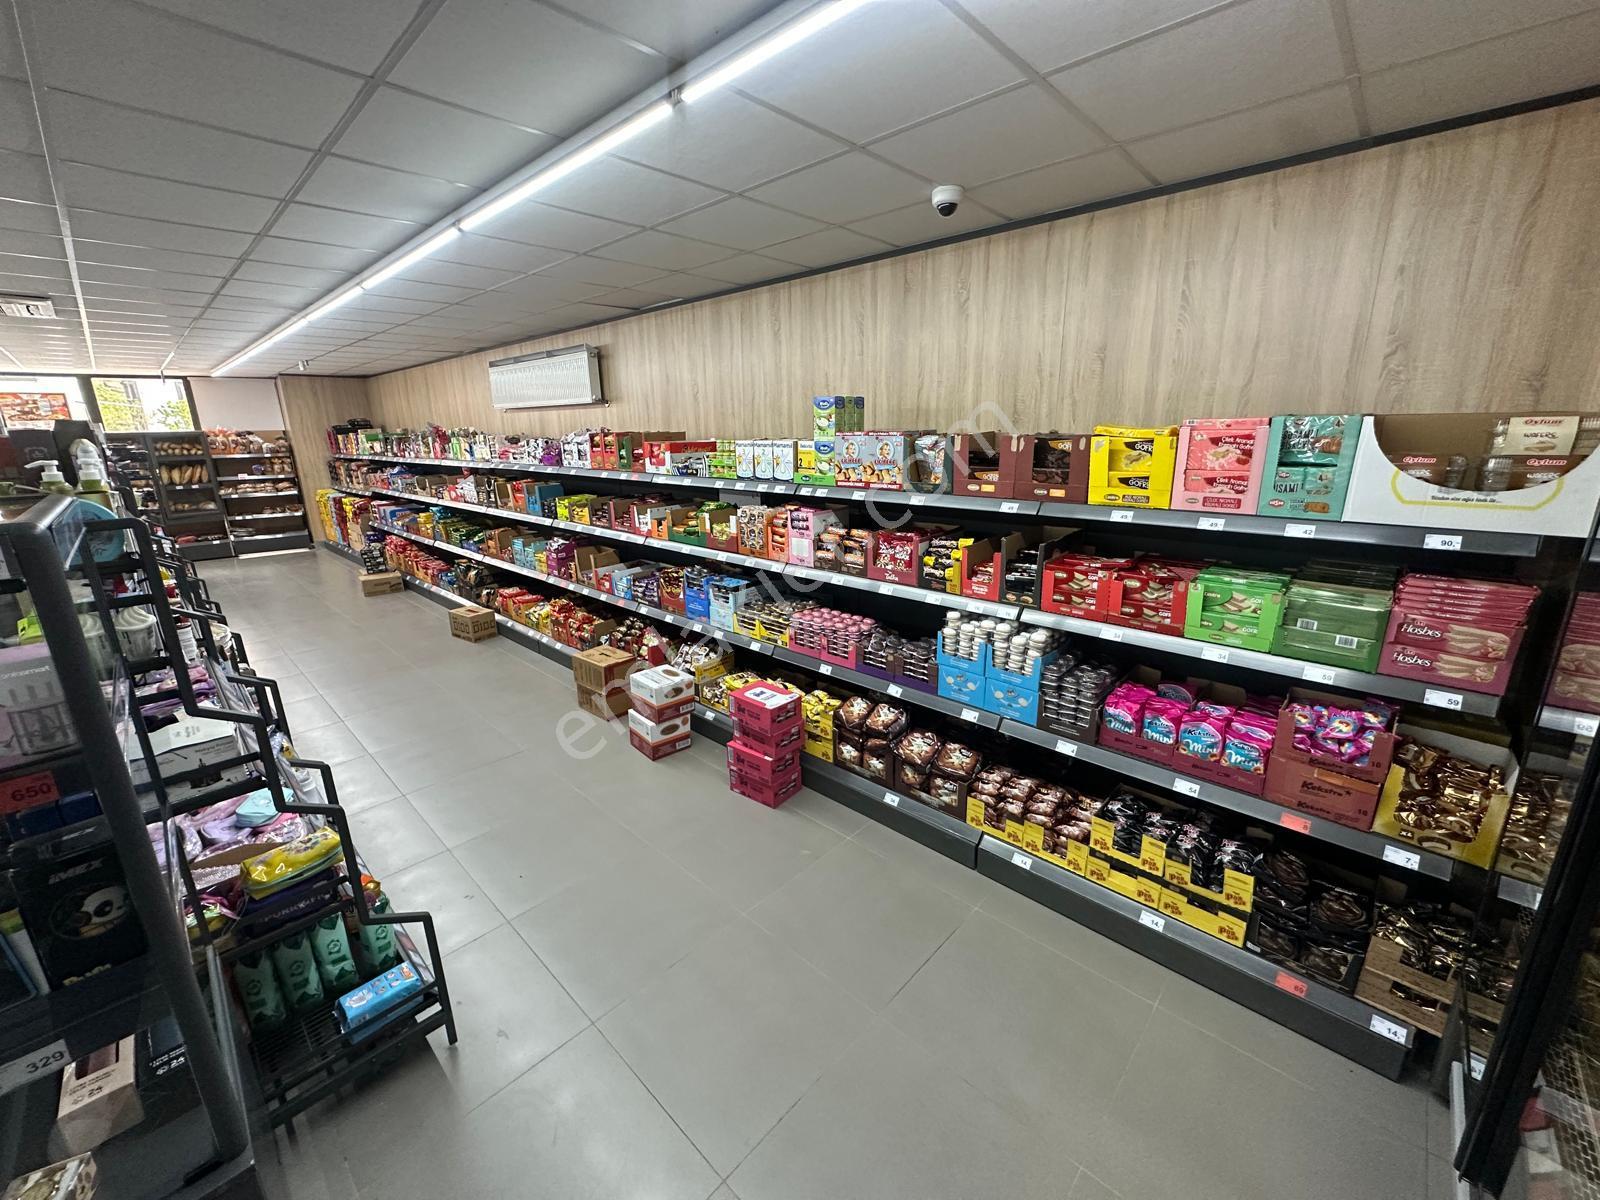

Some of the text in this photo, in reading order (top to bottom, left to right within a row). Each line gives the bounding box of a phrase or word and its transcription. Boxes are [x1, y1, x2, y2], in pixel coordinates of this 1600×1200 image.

[1403, 456, 1437, 464] Oylum
[1526, 458, 1567, 466] Oylum
[1447, 698, 1460, 707] 59
[11, 783, 51, 801] 650
[26, 1051, 65, 1074] 329
